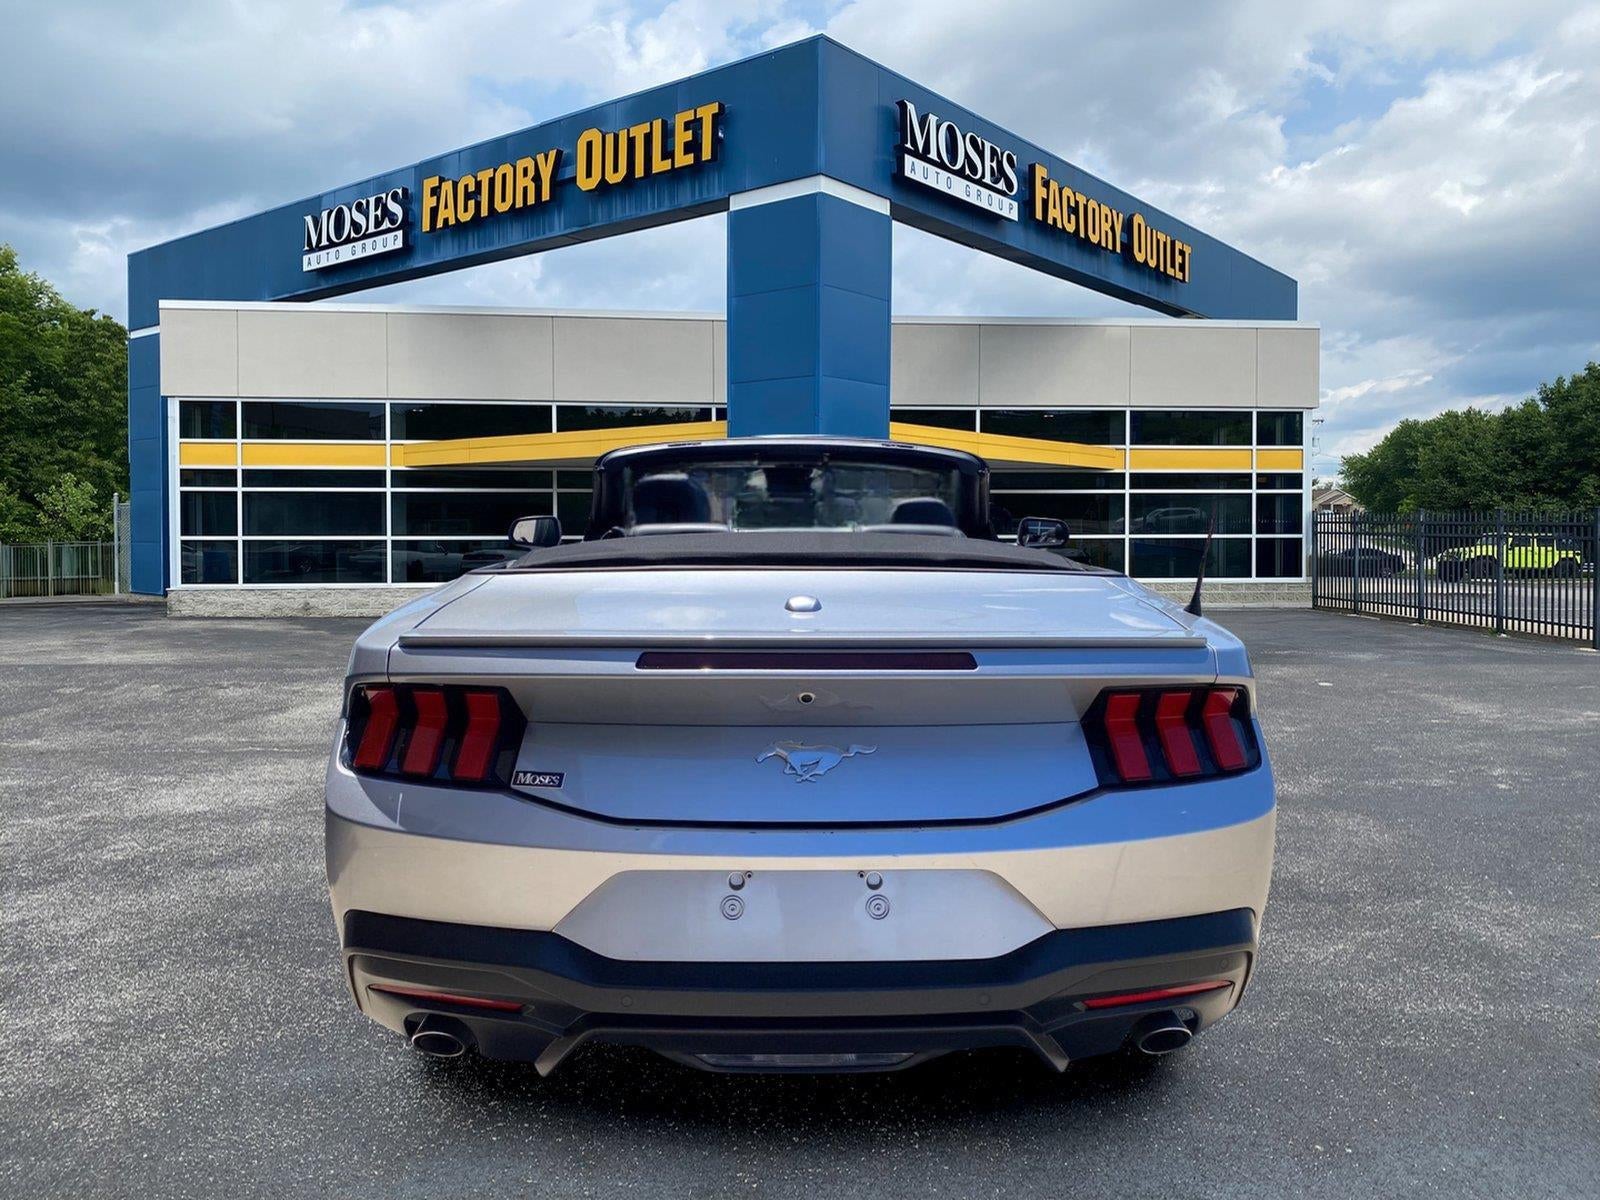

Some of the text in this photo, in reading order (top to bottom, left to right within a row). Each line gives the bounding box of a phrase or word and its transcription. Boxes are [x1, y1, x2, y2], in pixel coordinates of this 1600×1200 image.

[422, 101, 720, 232] FACTORY OUTLET
[903, 100, 1018, 196] MOSES
[303, 187, 403, 252] MOSES
[909, 161, 1015, 215] AUTO GROUP
[306, 234, 399, 268] AUTO GROUP
[1034, 163, 1192, 283] FACTORY OUTLET
[516, 772, 560, 785] MOSES
